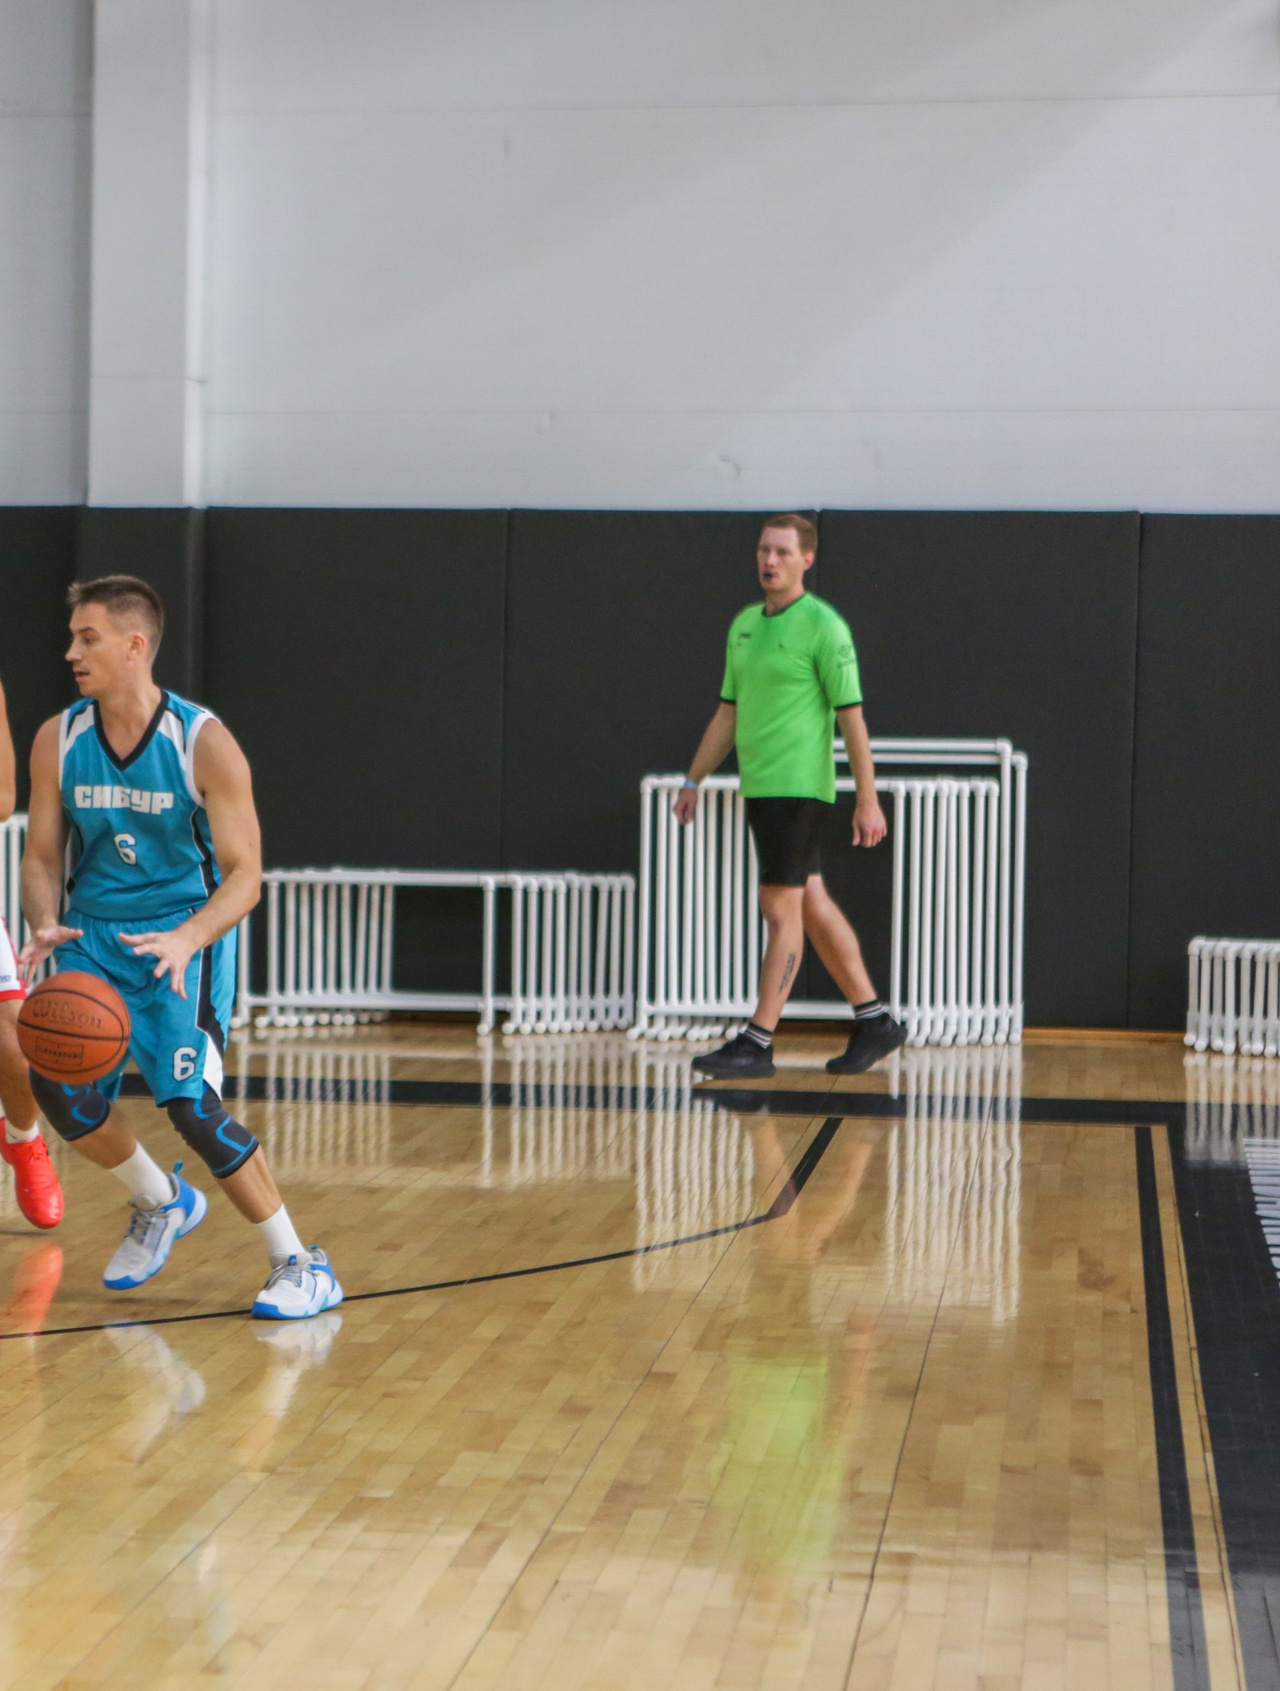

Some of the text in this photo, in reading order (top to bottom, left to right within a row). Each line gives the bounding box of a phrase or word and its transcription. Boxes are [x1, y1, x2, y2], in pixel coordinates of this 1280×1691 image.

[74, 785, 174, 815] СИБУР
[113, 833, 137, 866] 6
[173, 1046, 198, 1082] 6
